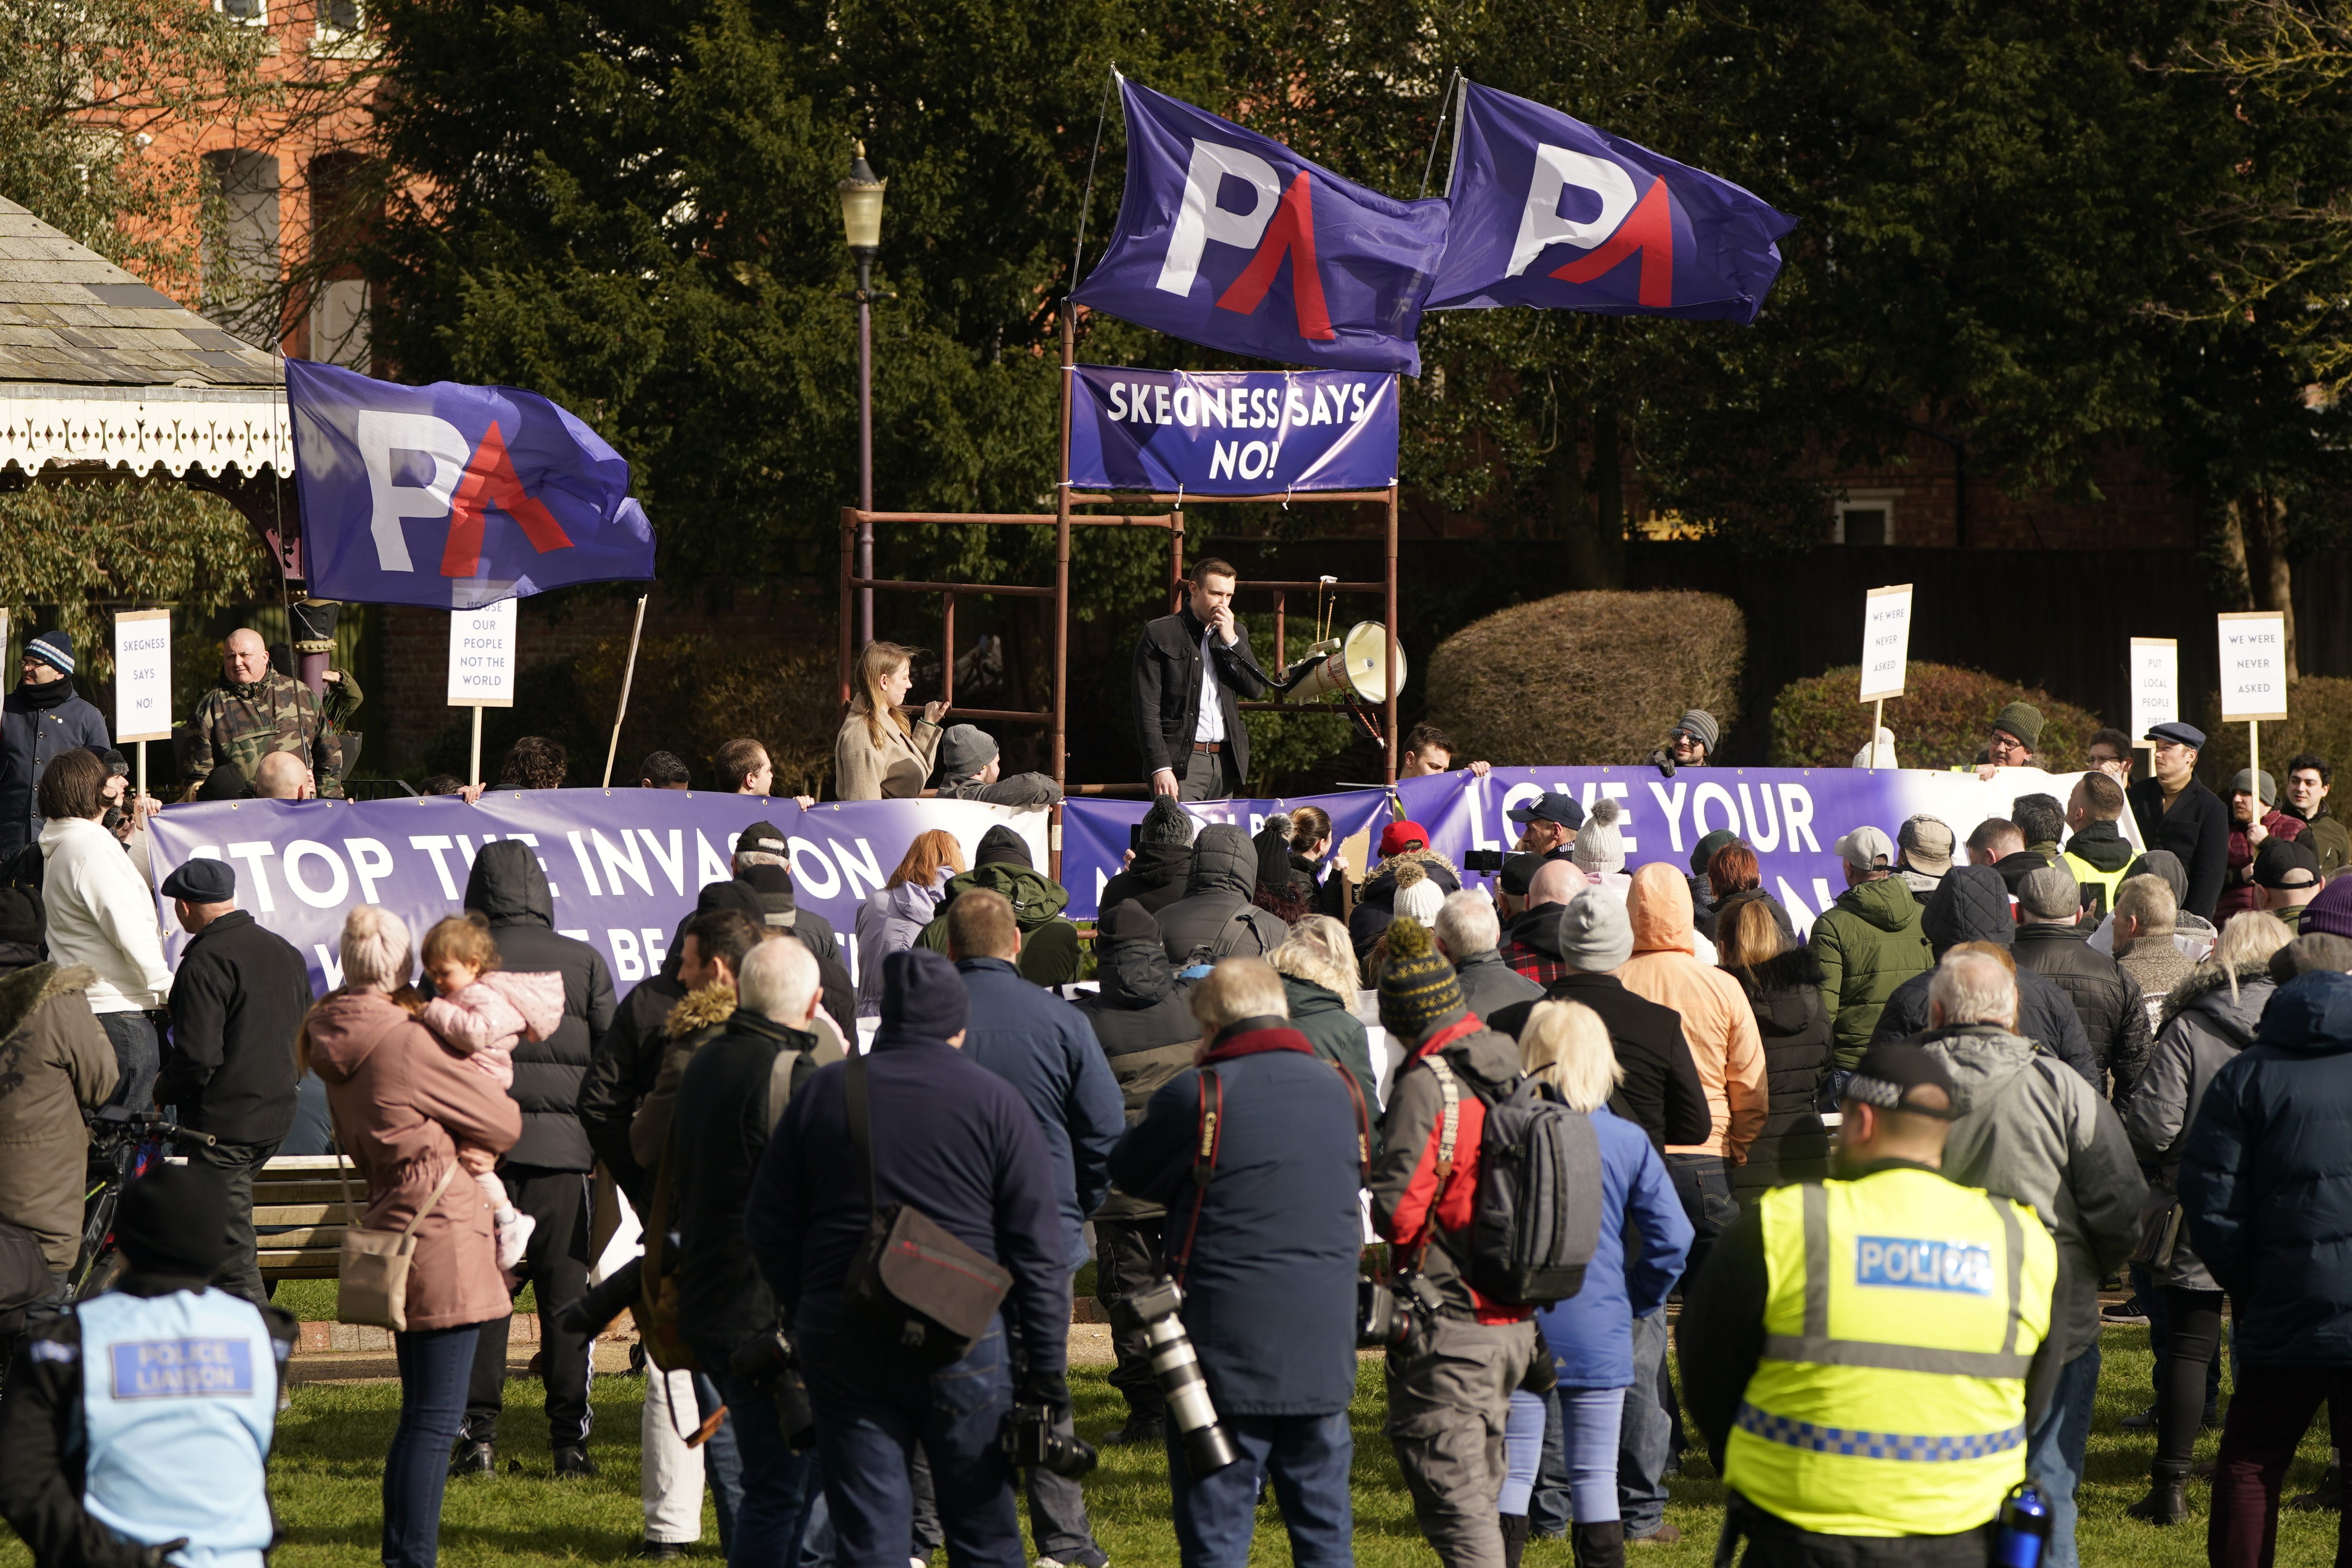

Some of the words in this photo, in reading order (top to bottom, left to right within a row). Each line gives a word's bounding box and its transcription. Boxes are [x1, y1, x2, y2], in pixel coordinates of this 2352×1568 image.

[1107, 382, 1280, 428] SKEGNESS
[1290, 382, 1366, 427] SAYS
[1209, 440, 1281, 480] NO!
[1872, 612, 1883, 621] WE
[1886, 609, 1904, 619] WERE
[472, 619, 496, 630] OUR
[124, 638, 165, 651] SKEGNESS
[464, 638, 502, 649] PEOPLE
[1876, 635, 1897, 646] NEVER
[2229, 635, 2244, 644] WE
[2248, 634, 2276, 643] WERE
[461, 657, 483, 667] NOT
[487, 657, 505, 667] THE
[1874, 660, 1895, 672] ASKED
[2148, 659, 2162, 668] PUT
[2237, 659, 2270, 668] NEVER
[133, 668, 155, 680] SAYS
[462, 675, 501, 686] WORLD
[2144, 679, 2167, 688] LOCAL
[2238, 684, 2271, 693] ASKED
[137, 698, 153, 709] NO!
[2143, 698, 2170, 707] PEOPLE
[2148, 717, 2166, 726] FIRST
[1648, 782, 1822, 853] YOUR
[567, 828, 887, 900] INVAON
[607, 928, 666, 981] BE
[1861, 1241, 1989, 1287] POLICE
[139, 1343, 229, 1366] POLICE
[137, 1366, 235, 1390] LIAISON
